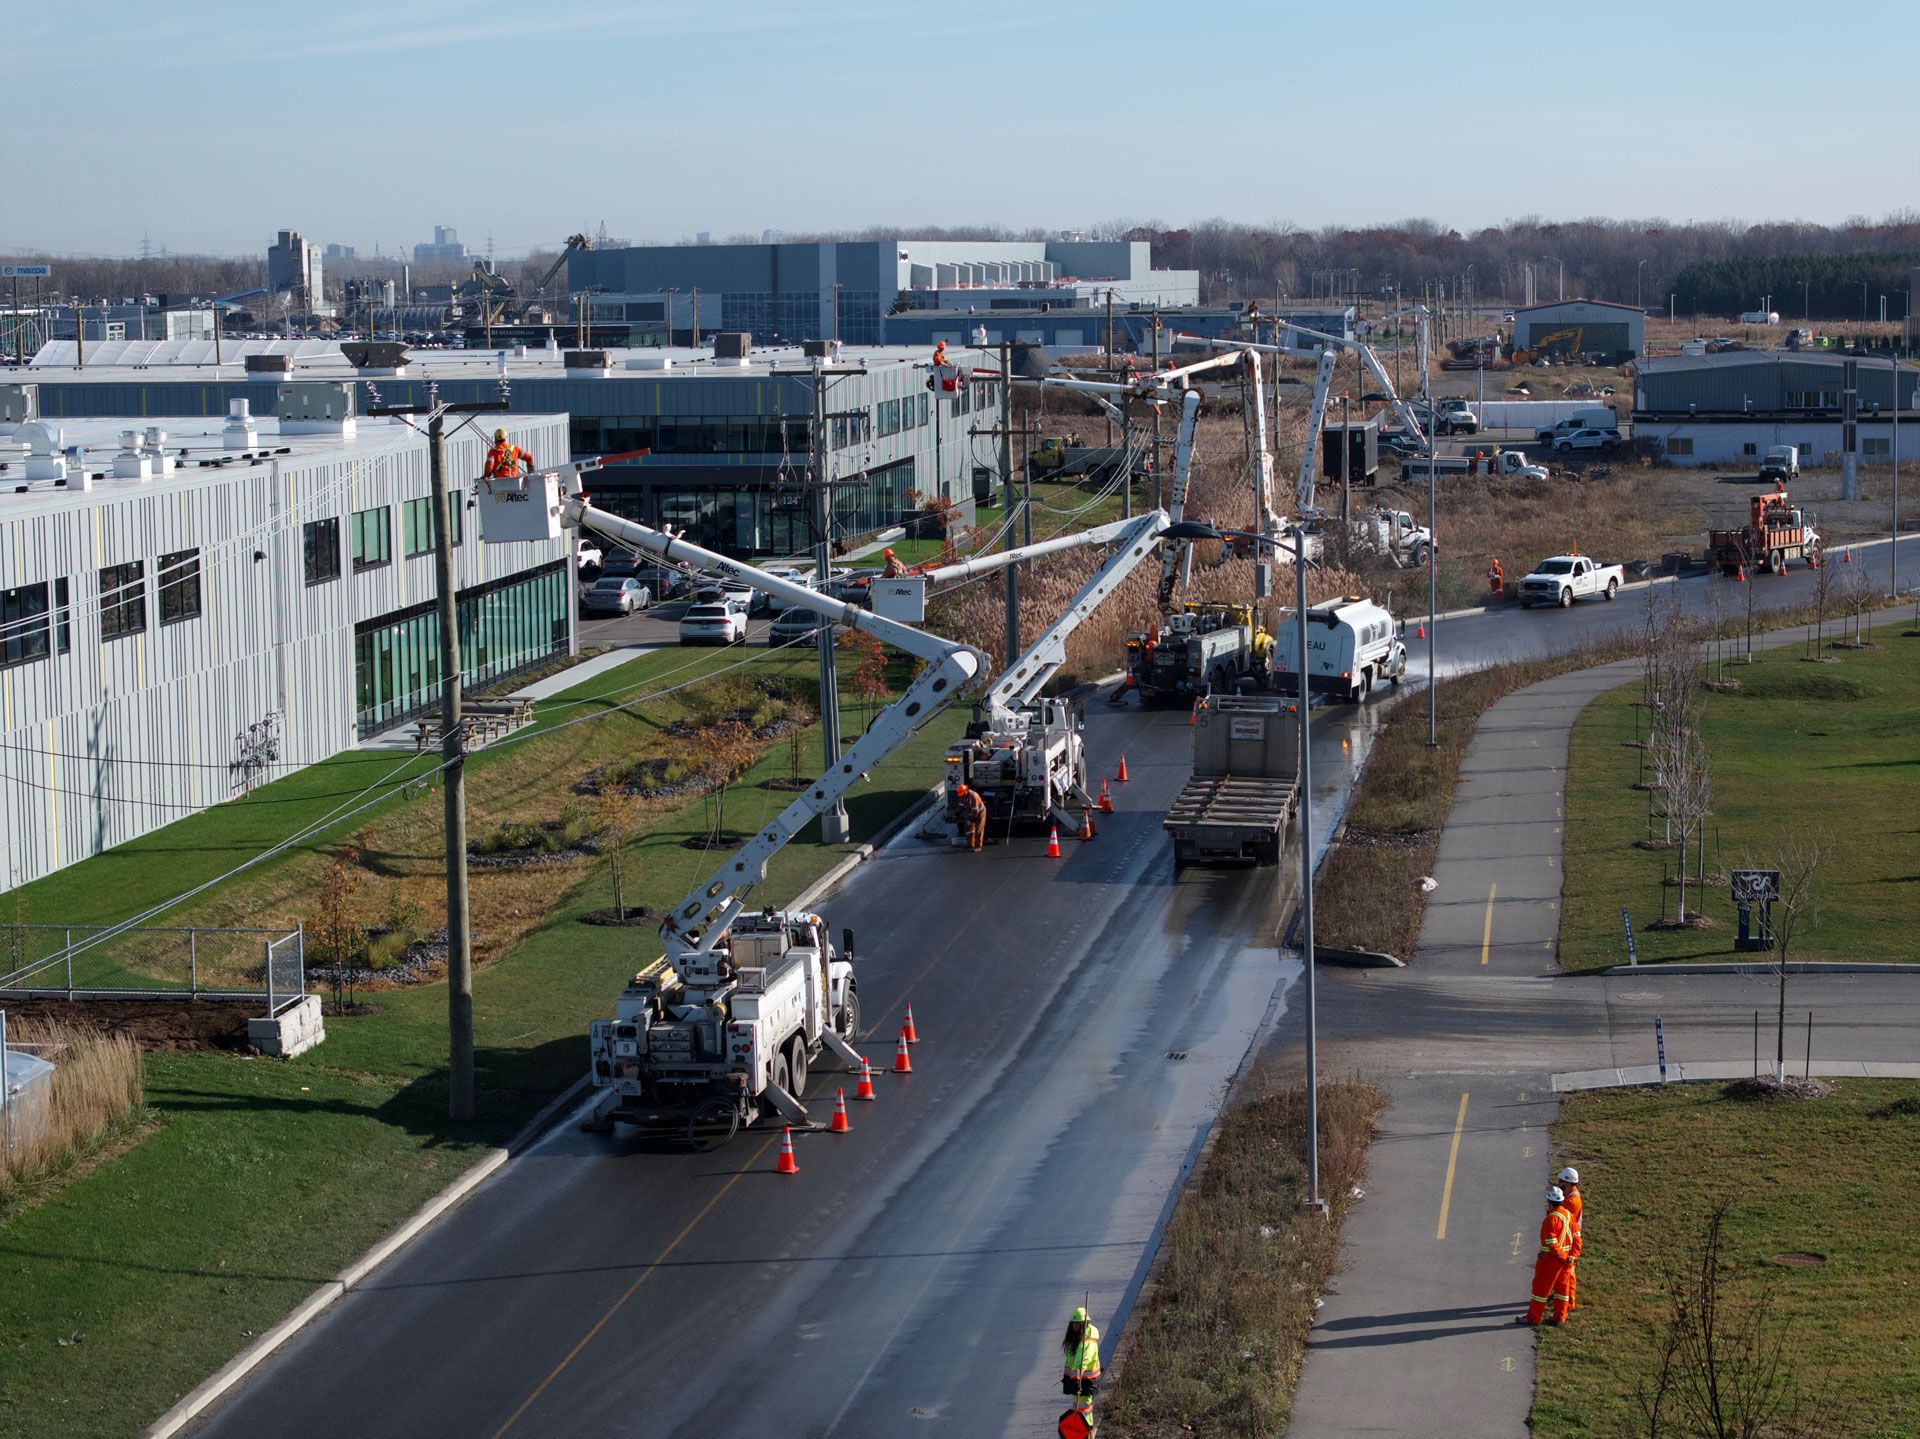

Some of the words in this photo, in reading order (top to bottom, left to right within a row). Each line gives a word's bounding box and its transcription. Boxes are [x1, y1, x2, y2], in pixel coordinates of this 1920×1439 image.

[505, 492, 529, 503] Altec
[783, 496, 798, 505] 124
[716, 561, 740, 577] Altec
[895, 588, 912, 596] Altec
[1307, 640, 1326, 651] EAU
[1200, 715, 1209, 728] 5
